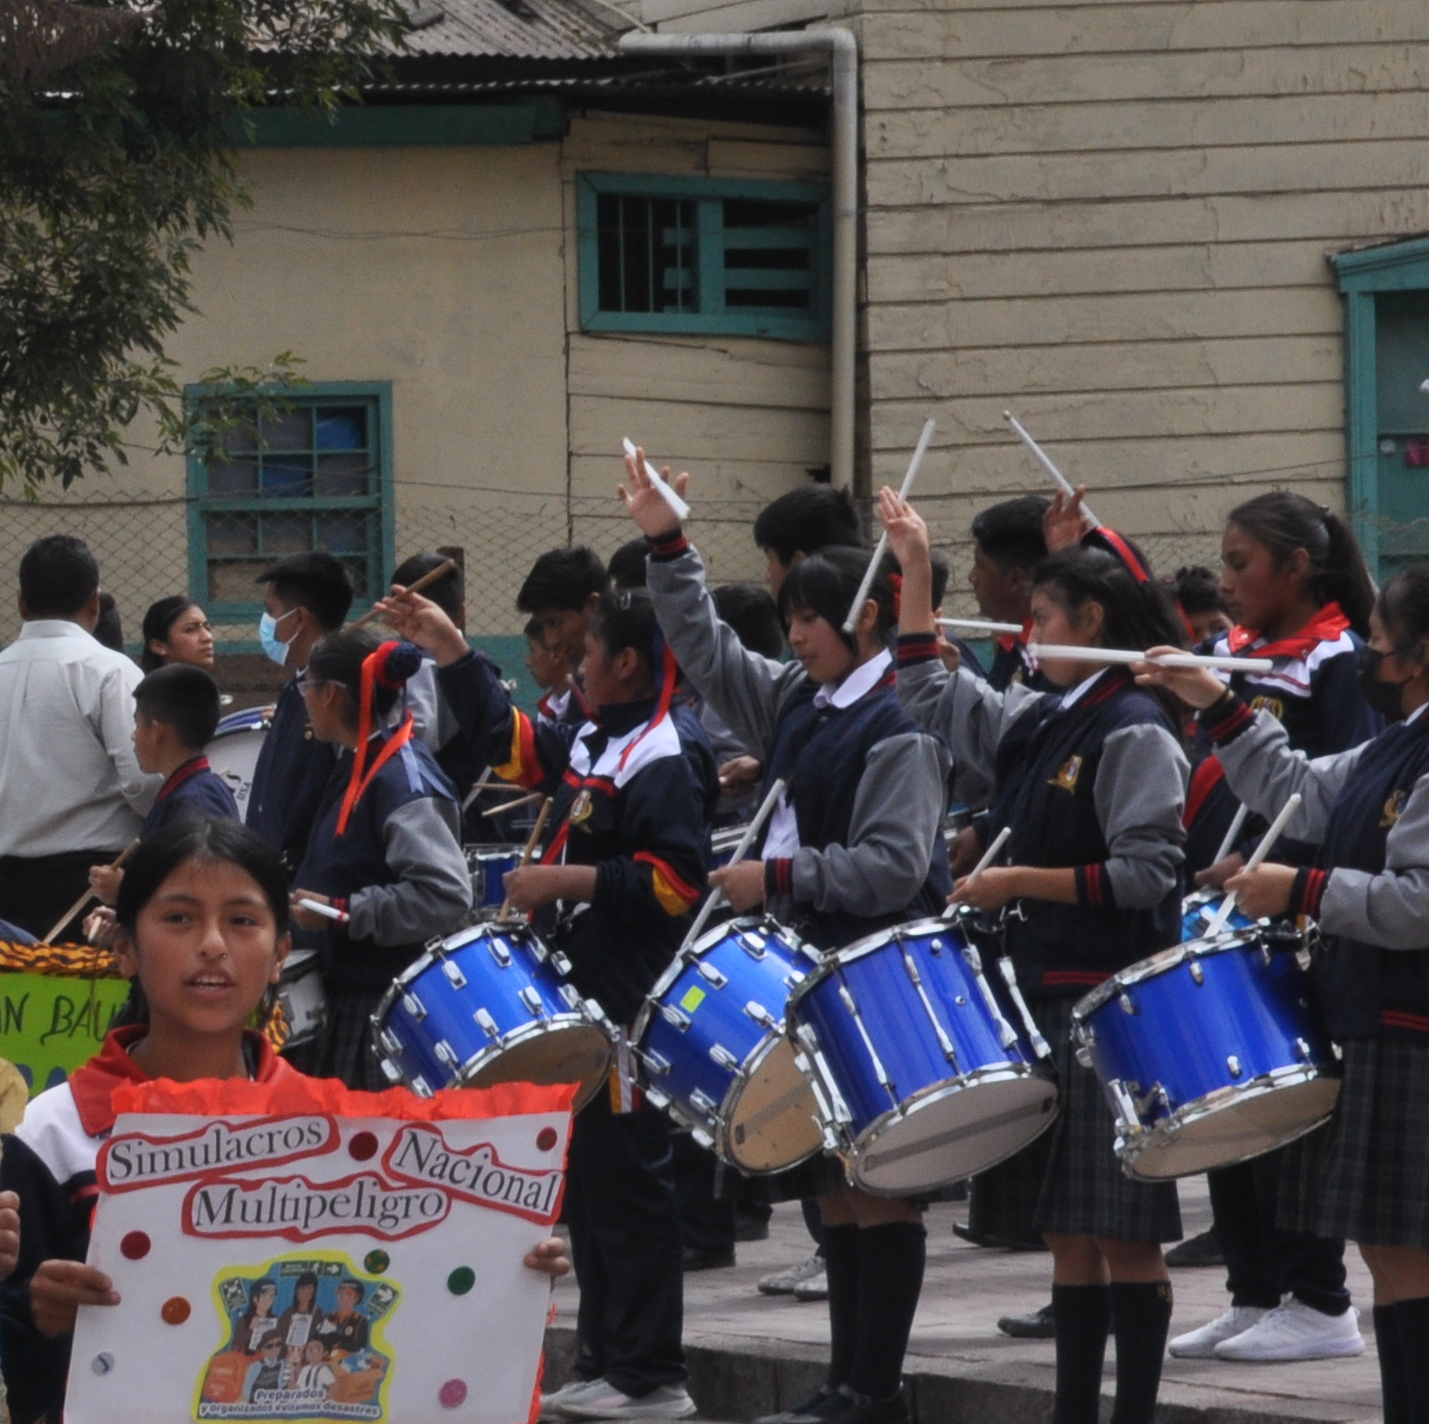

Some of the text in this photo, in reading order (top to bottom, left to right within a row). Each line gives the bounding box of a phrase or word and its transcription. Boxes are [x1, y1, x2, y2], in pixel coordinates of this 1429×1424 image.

[109, 1117, 559, 1214] Simulacros Nacional
[194, 1181, 445, 1229] Multipeligro
[210, 1403, 273, 1415] organizados
[323, 1402, 378, 1416] desastres
[256, 1389, 325, 1402] Preparados
